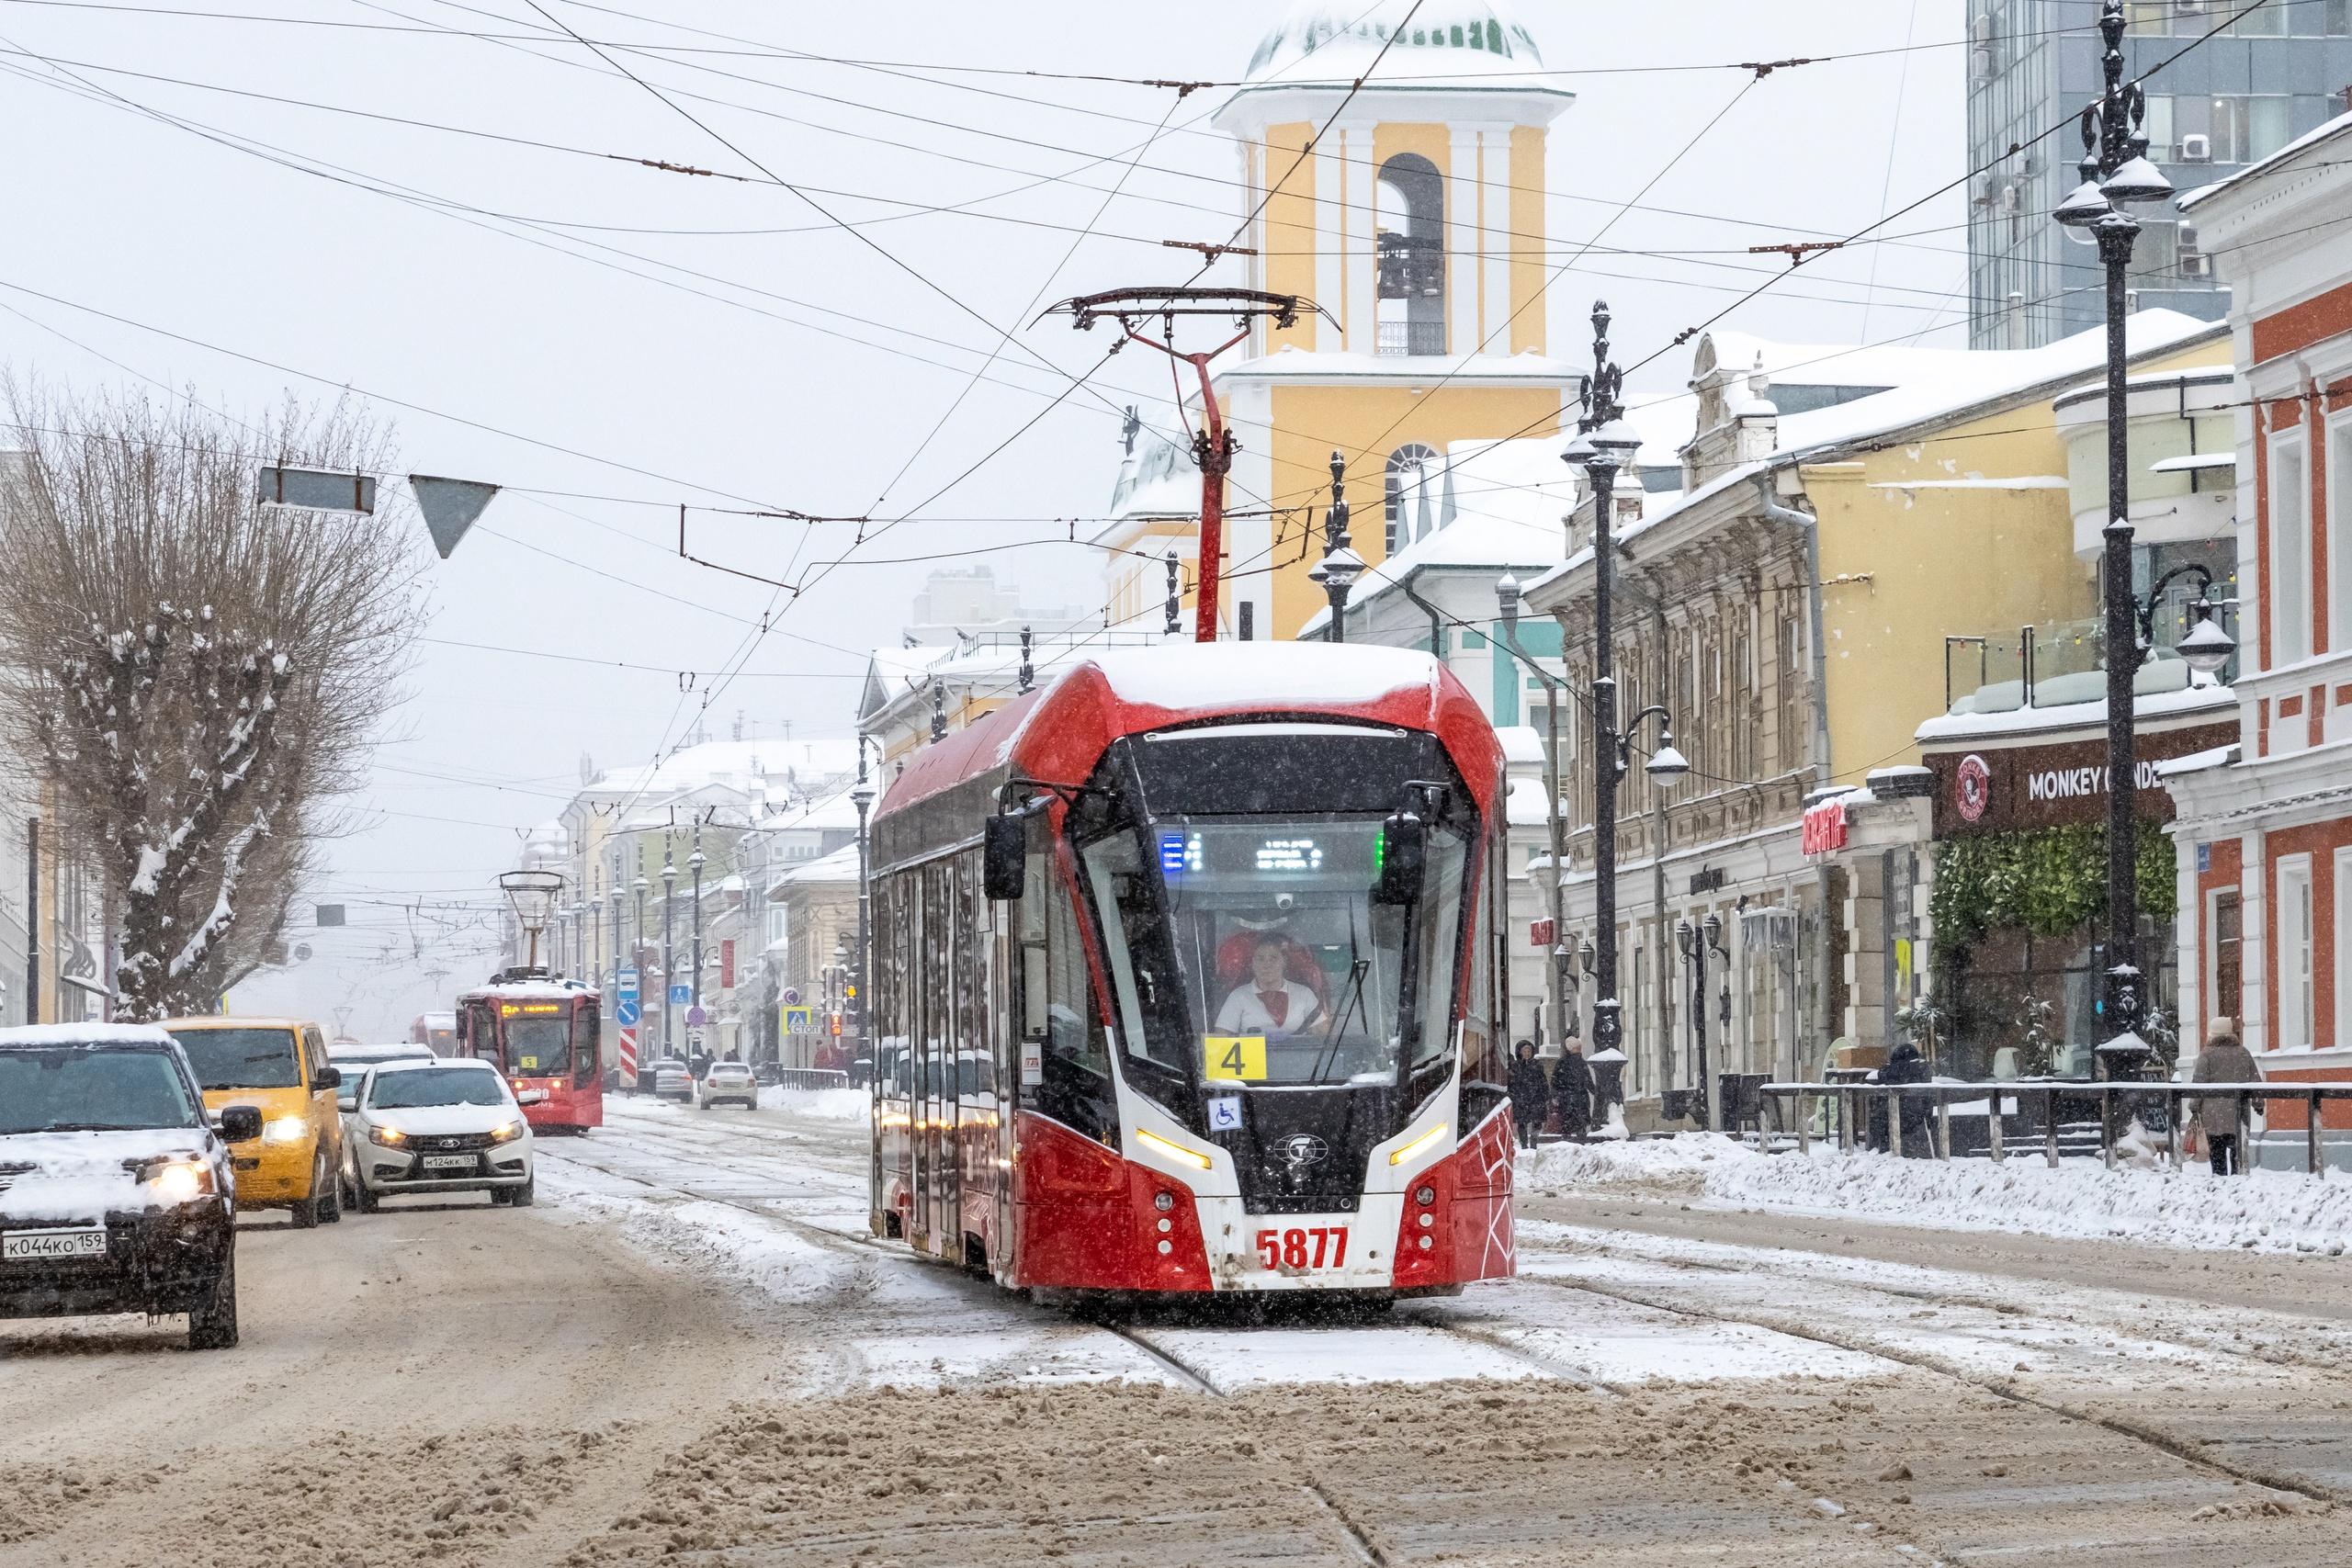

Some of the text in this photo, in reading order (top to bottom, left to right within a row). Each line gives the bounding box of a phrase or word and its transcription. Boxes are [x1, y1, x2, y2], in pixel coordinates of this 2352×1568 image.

[1958, 761, 1984, 781] MONKEY
[2029, 765, 2101, 801] MONKEY
[794, 1025, 819, 1033] СТОП
[526, 1057, 532, 1066] 5
[1220, 1042, 1246, 1076] 4
[9, 1235, 102, 1255] К044КО 159
[1256, 1227, 1349, 1270] 5877
